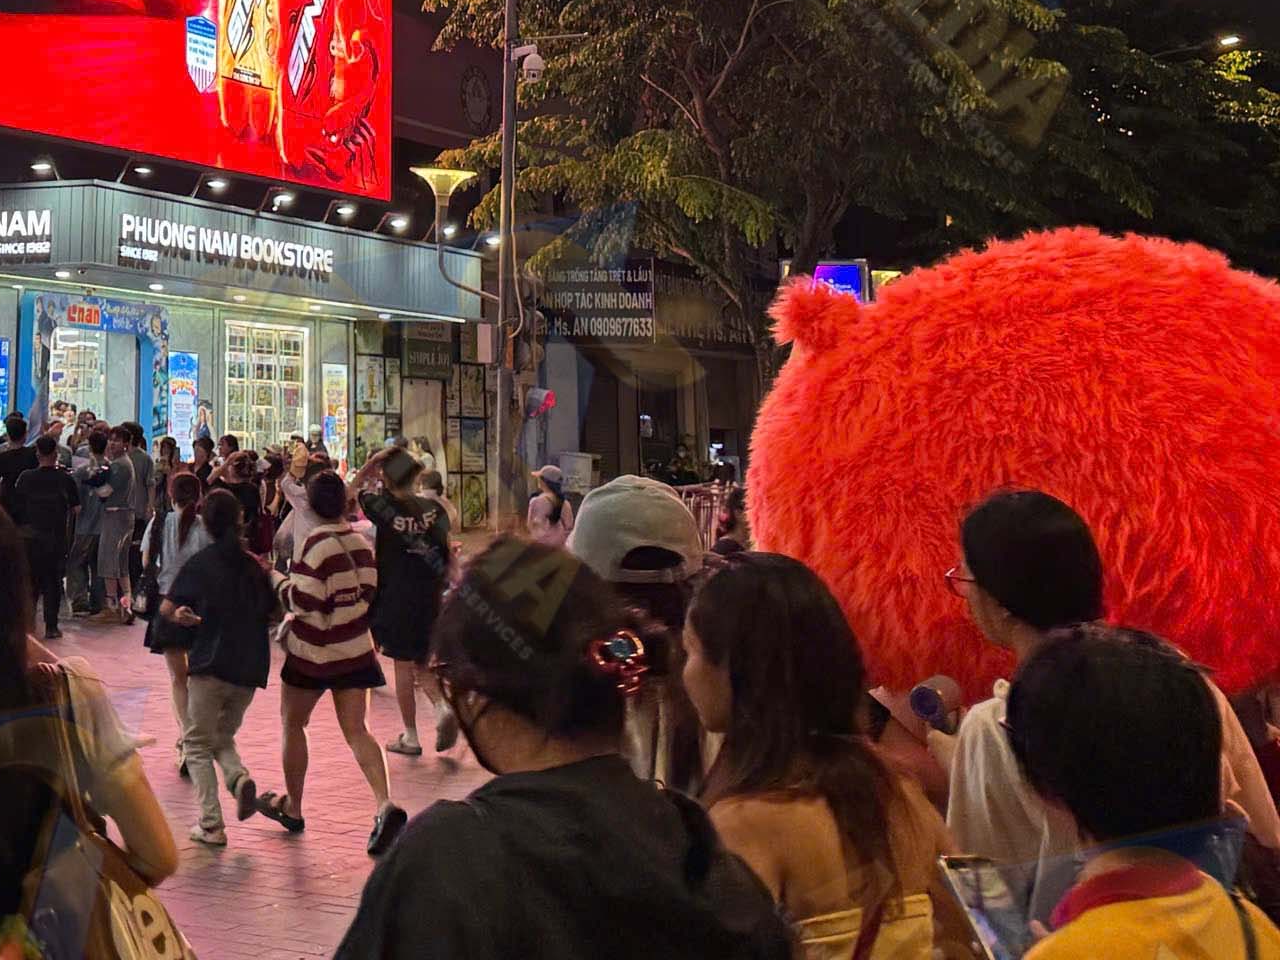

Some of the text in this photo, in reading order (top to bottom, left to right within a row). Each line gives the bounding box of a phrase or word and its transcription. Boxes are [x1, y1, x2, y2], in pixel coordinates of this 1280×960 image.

[26, 240, 51, 254] 1982
[121, 213, 334, 273] PHUONG NAM BOOKSTORE
[555, 288, 652, 313] HỢP TÁC KINH DOANH
[573, 317, 589, 336] AN
[590, 317, 653, 337] 0909677633
